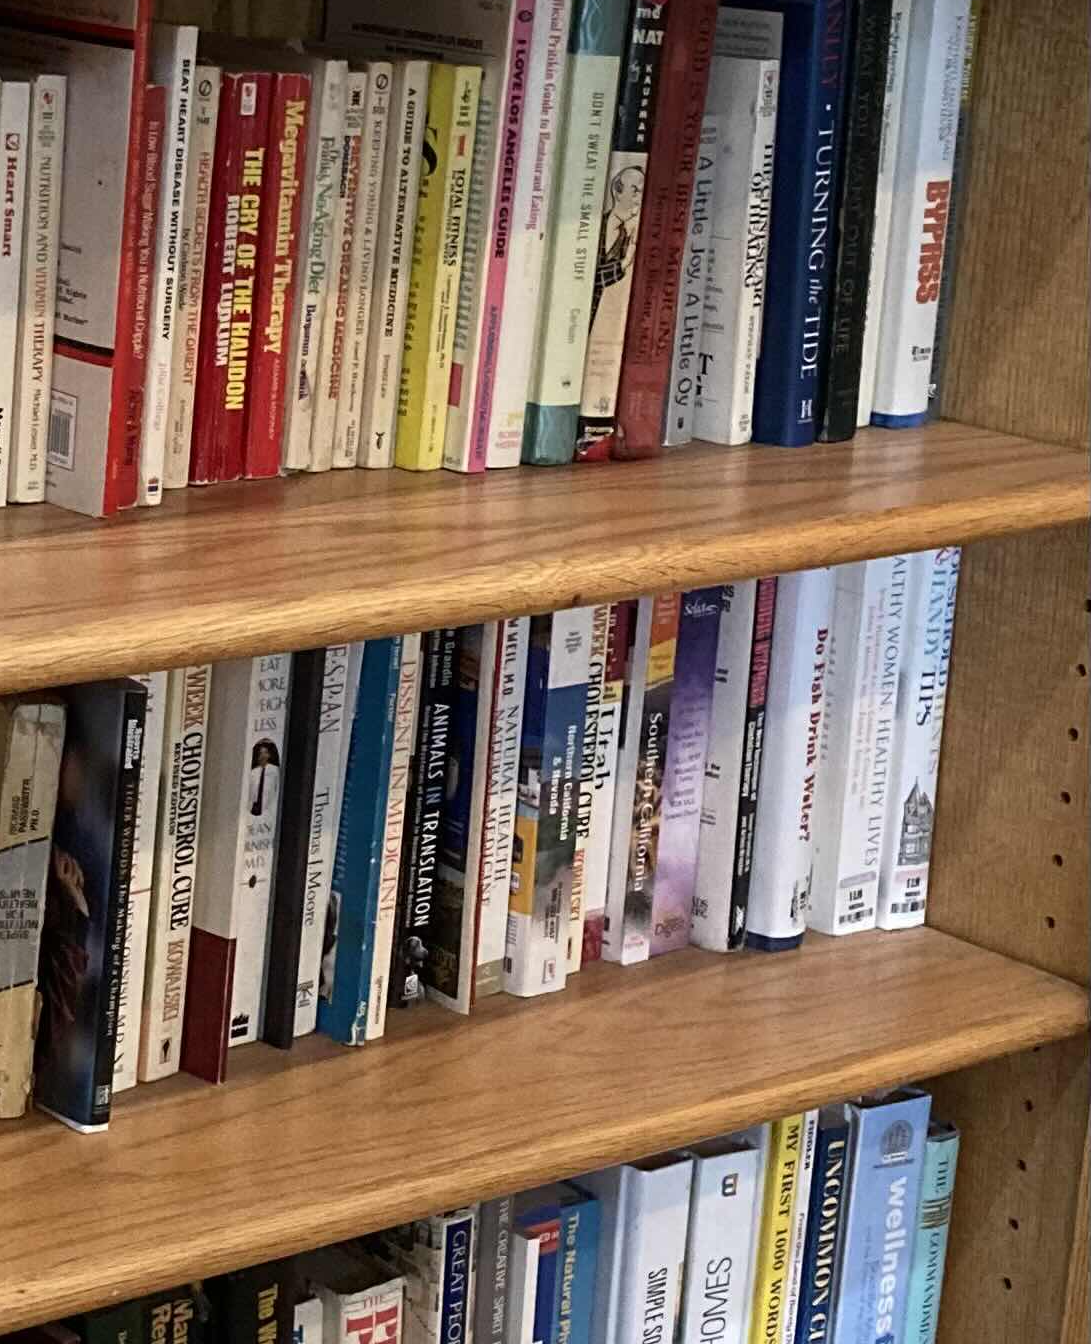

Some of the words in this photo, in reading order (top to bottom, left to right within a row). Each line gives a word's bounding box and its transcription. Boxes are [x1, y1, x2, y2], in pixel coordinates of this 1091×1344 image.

[180, 59, 191, 92] BEAT
[175, 99, 188, 144] HEART
[590, 93, 605, 127] DON'T
[171, 148, 185, 206] DISEASE
[242, 147, 266, 186] THE
[585, 134, 600, 170] SWEAT
[698, 157, 715, 171] A
[4, 156, 18, 203] Heart
[35, 156, 56, 229] NUTRITION
[274, 100, 306, 256] Megavitamin
[452, 168, 467, 208] TOTAL
[582, 178, 595, 198] THE
[1, 209, 15, 256] Smart
[238, 194, 261, 235] CRY
[576, 205, 591, 240] SMALL
[691, 179, 713, 235] Little
[35, 233, 49, 262] AND
[166, 210, 180, 272] WITHOUT
[221, 195, 241, 275] ROBERT
[235, 244, 257, 268] OF
[446, 216, 461, 267] FITNESS
[573, 248, 587, 282] STUFF
[685, 248, 705, 284] Joy,
[32, 266, 48, 317] VITAMIN
[161, 277, 175, 340] SURGERY
[231, 276, 256, 313] THE
[263, 259, 293, 354] Therapy
[683, 293, 701, 306] A
[213, 282, 235, 366] LUDLUM
[677, 316, 699, 369] Little
[31, 321, 46, 382] THERAPY
[223, 322, 252, 410] HALIDON
[674, 378, 694, 406] Oy
[441, 640, 457, 687] Grandin
[814, 629, 829, 655] Do
[183, 670, 208, 730] WEEK
[392, 660, 418, 753] DISSENT
[810, 663, 825, 704] Fish
[429, 704, 450, 779] ANIMALS
[564, 726, 577, 777] Northern
[805, 712, 822, 766] Drink
[171, 743, 182, 789] REVISED
[390, 765, 408, 789] IN
[168, 793, 179, 835] EDITION
[172, 732, 204, 873] CHOLESTEROL
[427, 787, 444, 805] IN
[559, 783, 573, 840] California
[798, 774, 816, 842] Water?
[377, 798, 404, 920] MEDICINE
[413, 811, 441, 927] TRANSLATION
[170, 876, 193, 930] CURE
[786, 1126, 799, 1152] MY
[778, 1160, 795, 1218] FIRST
[810, 1140, 844, 1306] UNCOMMON
[449, 1230, 466, 1295] GREAT
[771, 1229, 786, 1270] 1000
[647, 1268, 667, 1321] SIMPLE
